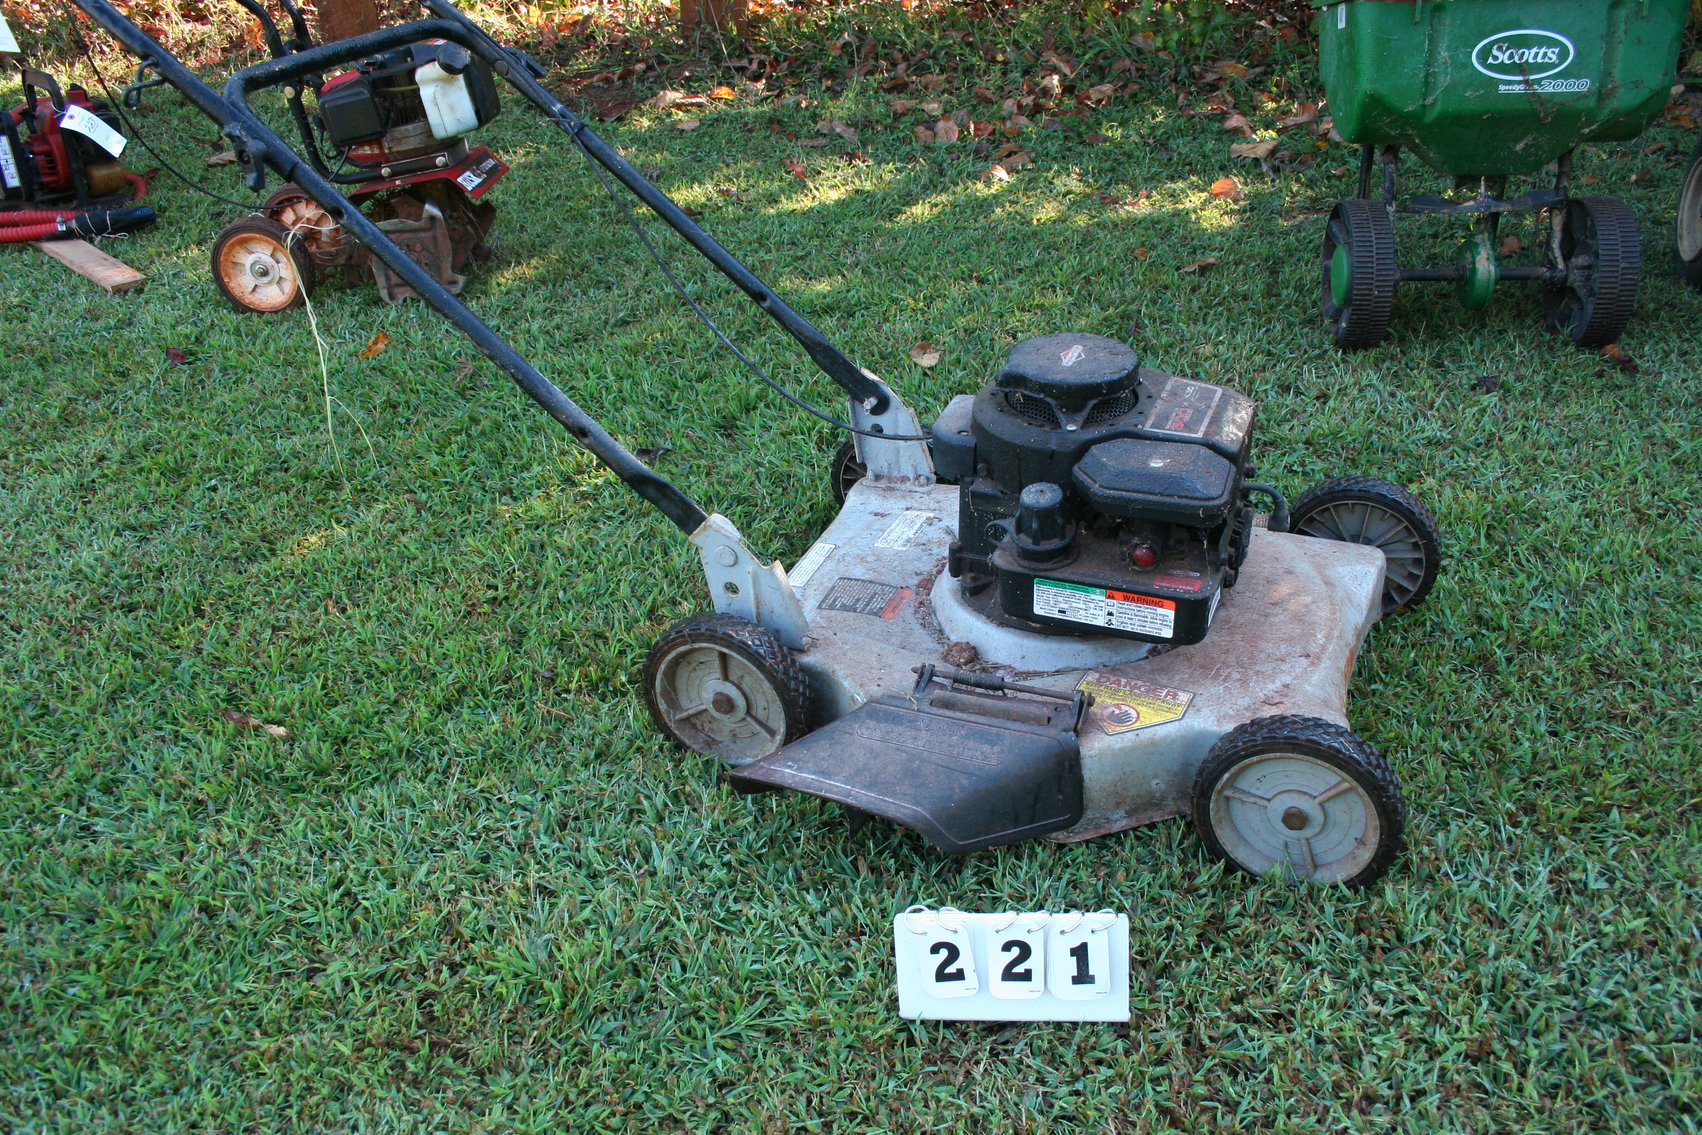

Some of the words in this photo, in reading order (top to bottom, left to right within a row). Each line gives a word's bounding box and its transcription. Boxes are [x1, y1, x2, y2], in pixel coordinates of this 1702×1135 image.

[1487, 43, 1559, 64] Scotts
[1540, 79, 1590, 91] 2000
[1122, 593, 1164, 608] WARNING
[1096, 674, 1179, 701] DANGER
[905, 714, 966, 737] CAUTION
